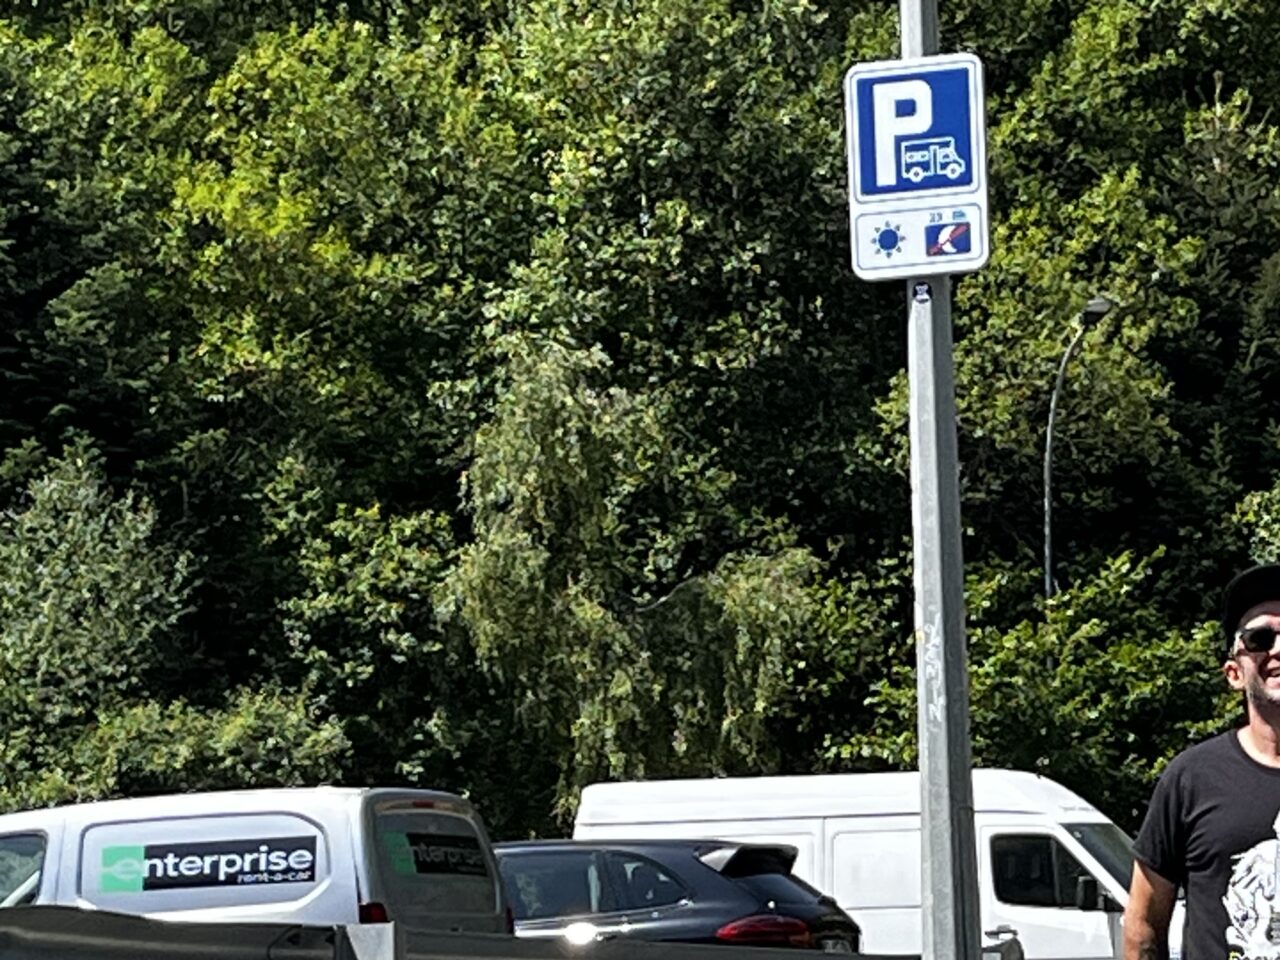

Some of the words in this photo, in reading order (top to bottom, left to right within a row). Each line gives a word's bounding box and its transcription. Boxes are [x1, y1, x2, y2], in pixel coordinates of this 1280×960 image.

[872, 79, 933, 188] P
[104, 845, 313, 881] enterprise
[237, 869, 312, 884] rent-a-car
